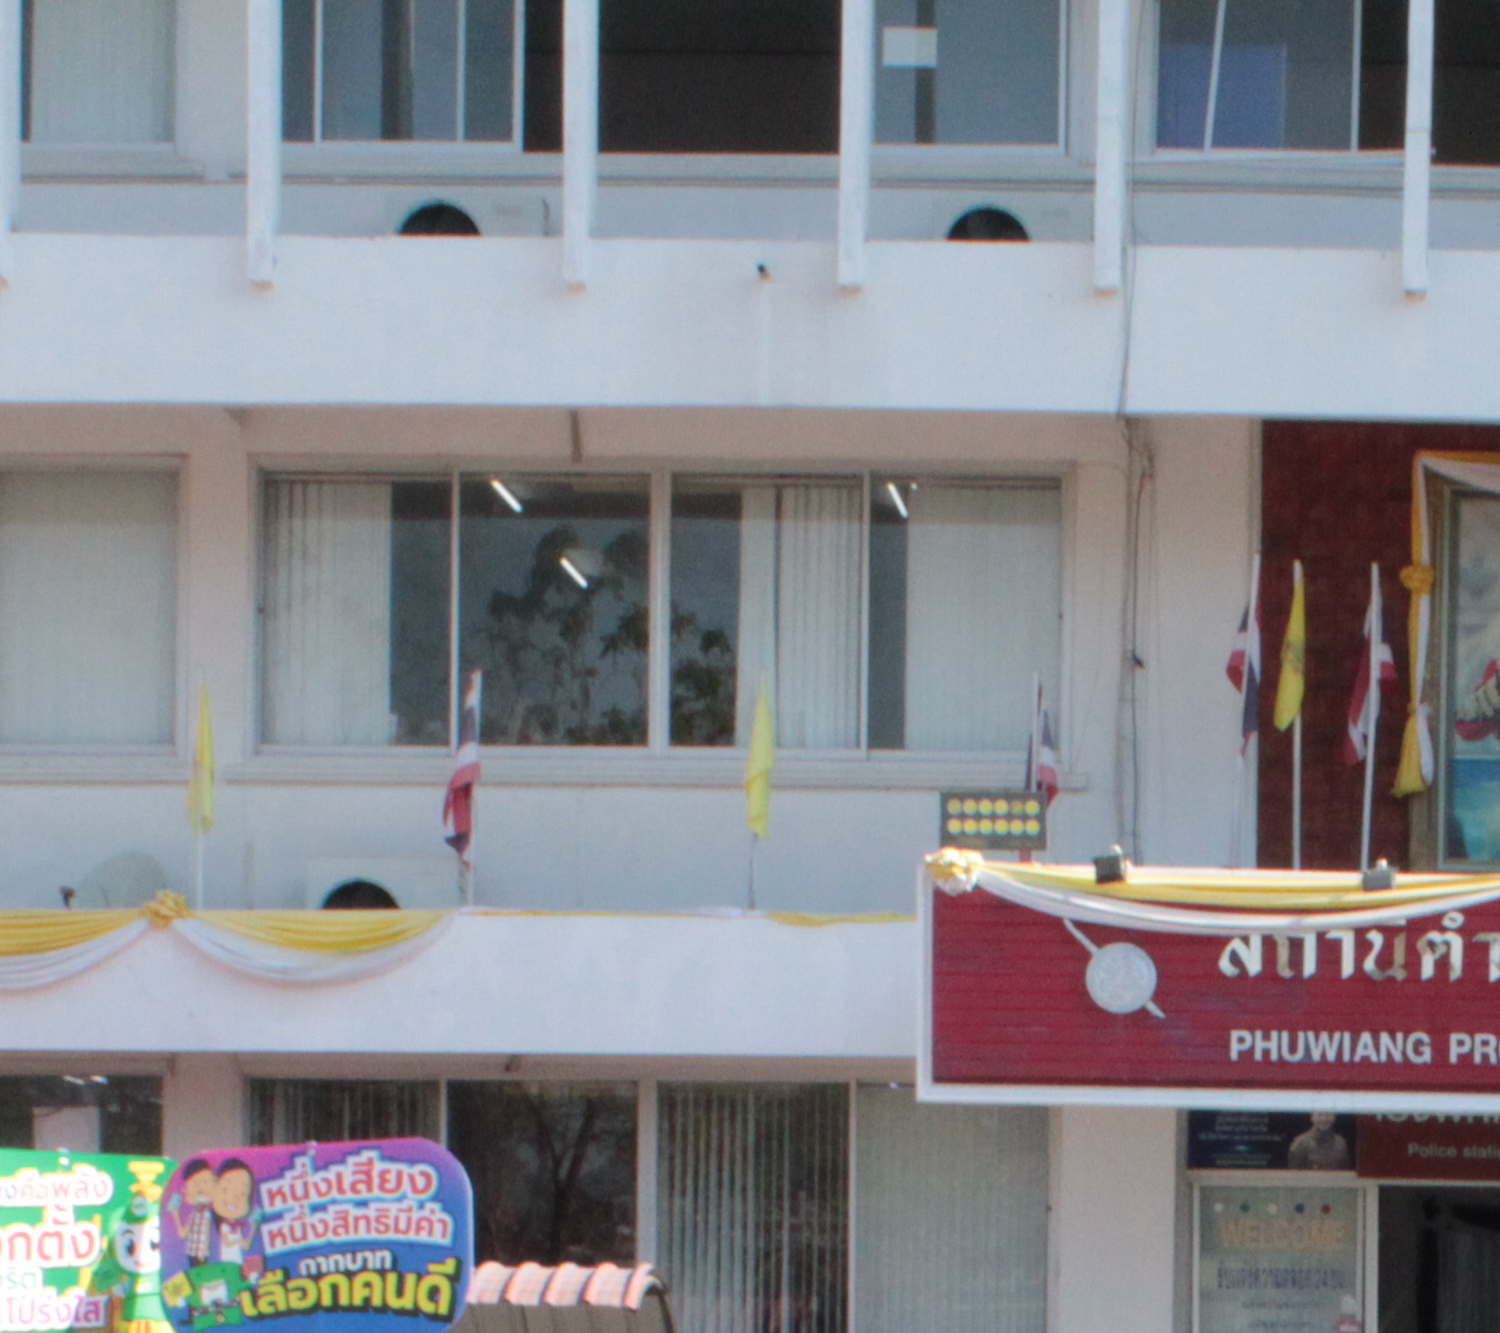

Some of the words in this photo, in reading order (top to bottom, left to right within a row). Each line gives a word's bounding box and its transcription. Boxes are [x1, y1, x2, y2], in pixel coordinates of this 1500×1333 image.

[1229, 1030, 1432, 1064] PHUWIANG
[1407, 1143, 1457, 1160] Police
[266, 1158, 435, 1210] หนึ่งเสียง
[299, 1251, 392, 1276] กากบาท
[242, 1260, 457, 1318] เลือกคนดี
